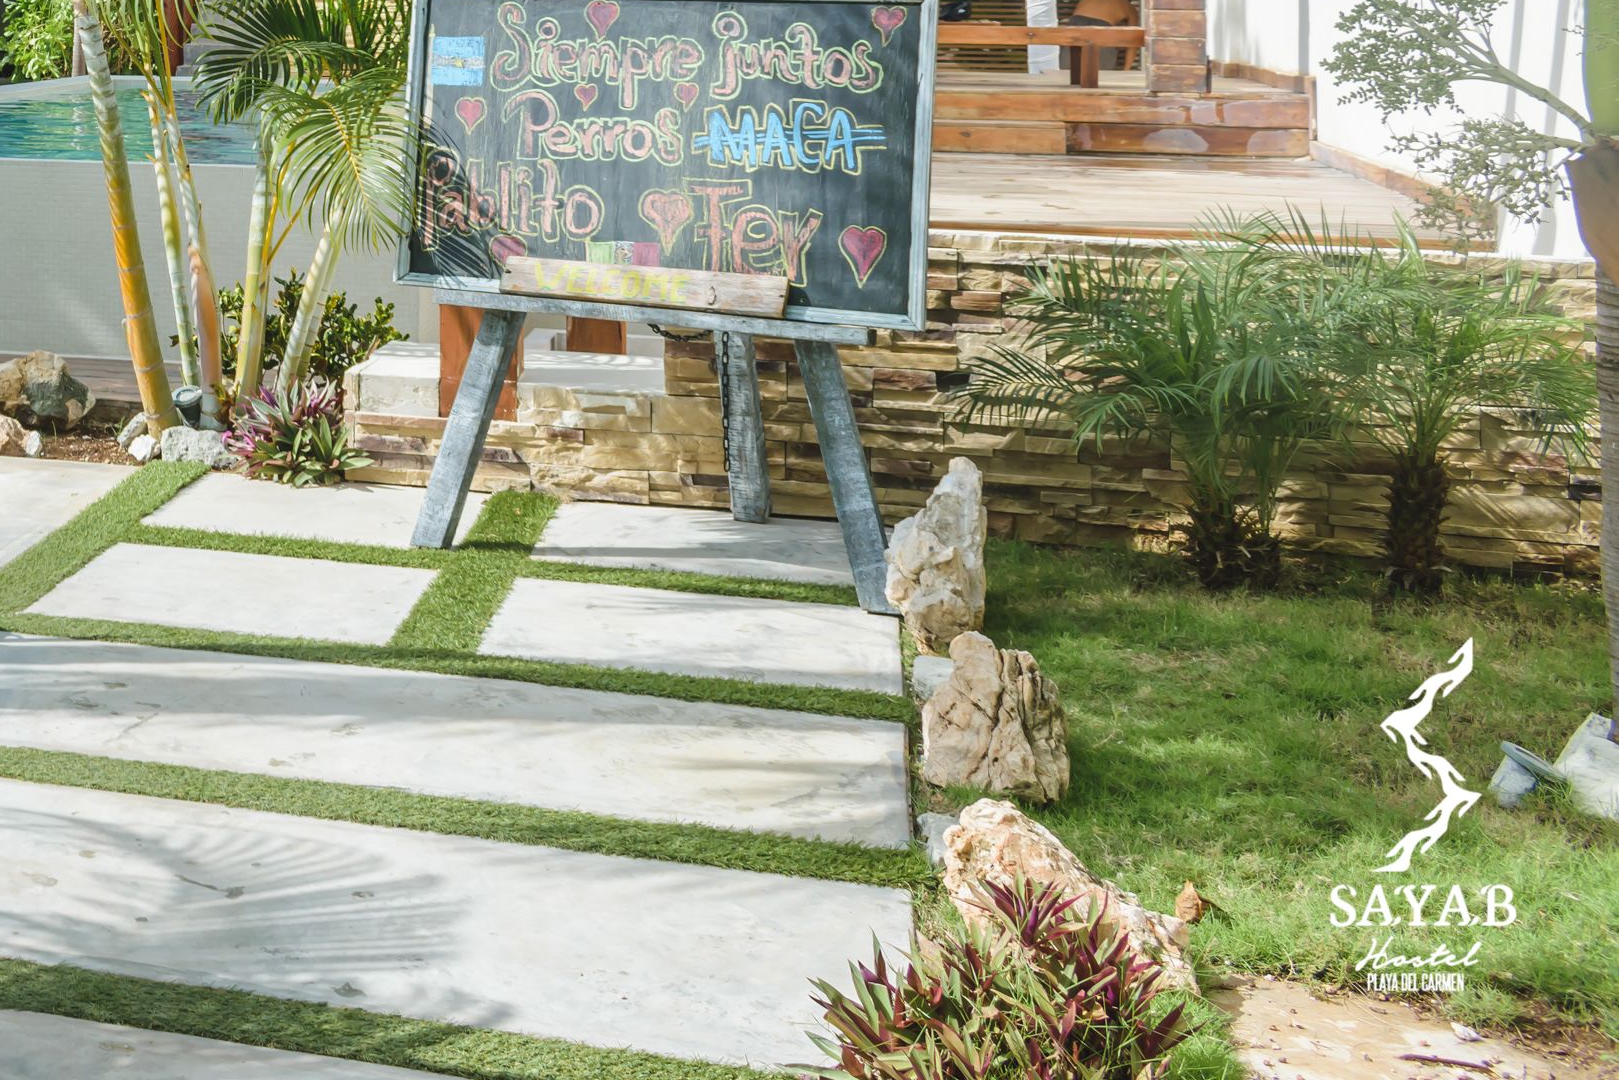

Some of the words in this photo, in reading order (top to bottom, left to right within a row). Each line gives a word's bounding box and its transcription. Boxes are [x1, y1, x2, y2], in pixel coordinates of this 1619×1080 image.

[490, 1, 705, 109] Siempre
[711, 11, 885, 101] juntos
[504, 90, 683, 166] Perros
[702, 98, 864, 175] MACA
[533, 260, 694, 304] WELCOME
